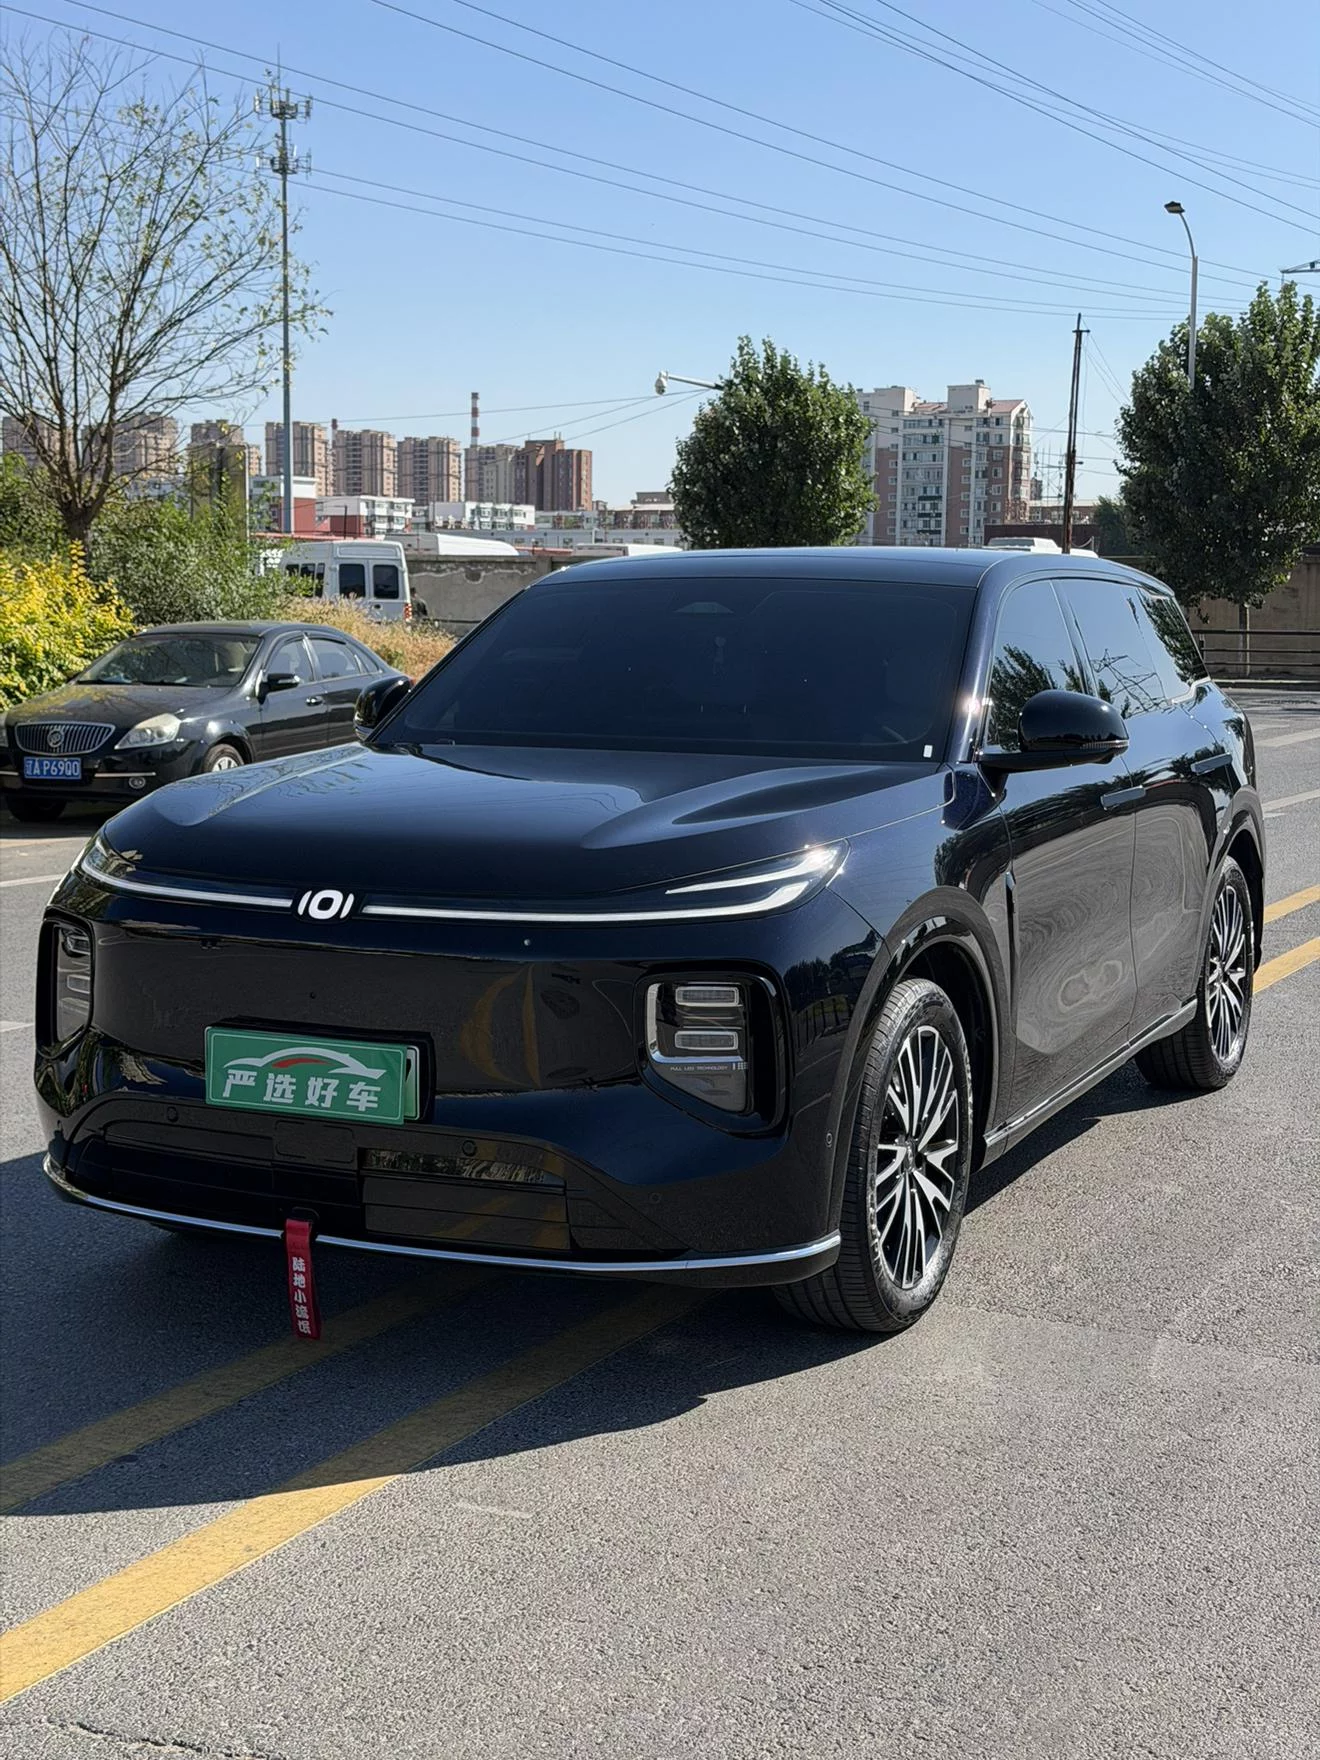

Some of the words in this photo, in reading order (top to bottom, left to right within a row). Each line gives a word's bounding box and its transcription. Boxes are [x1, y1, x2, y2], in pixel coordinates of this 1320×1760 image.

[221, 1069, 382, 1112] 严选好车
[292, 1256, 311, 1335] 陆地小流氓
